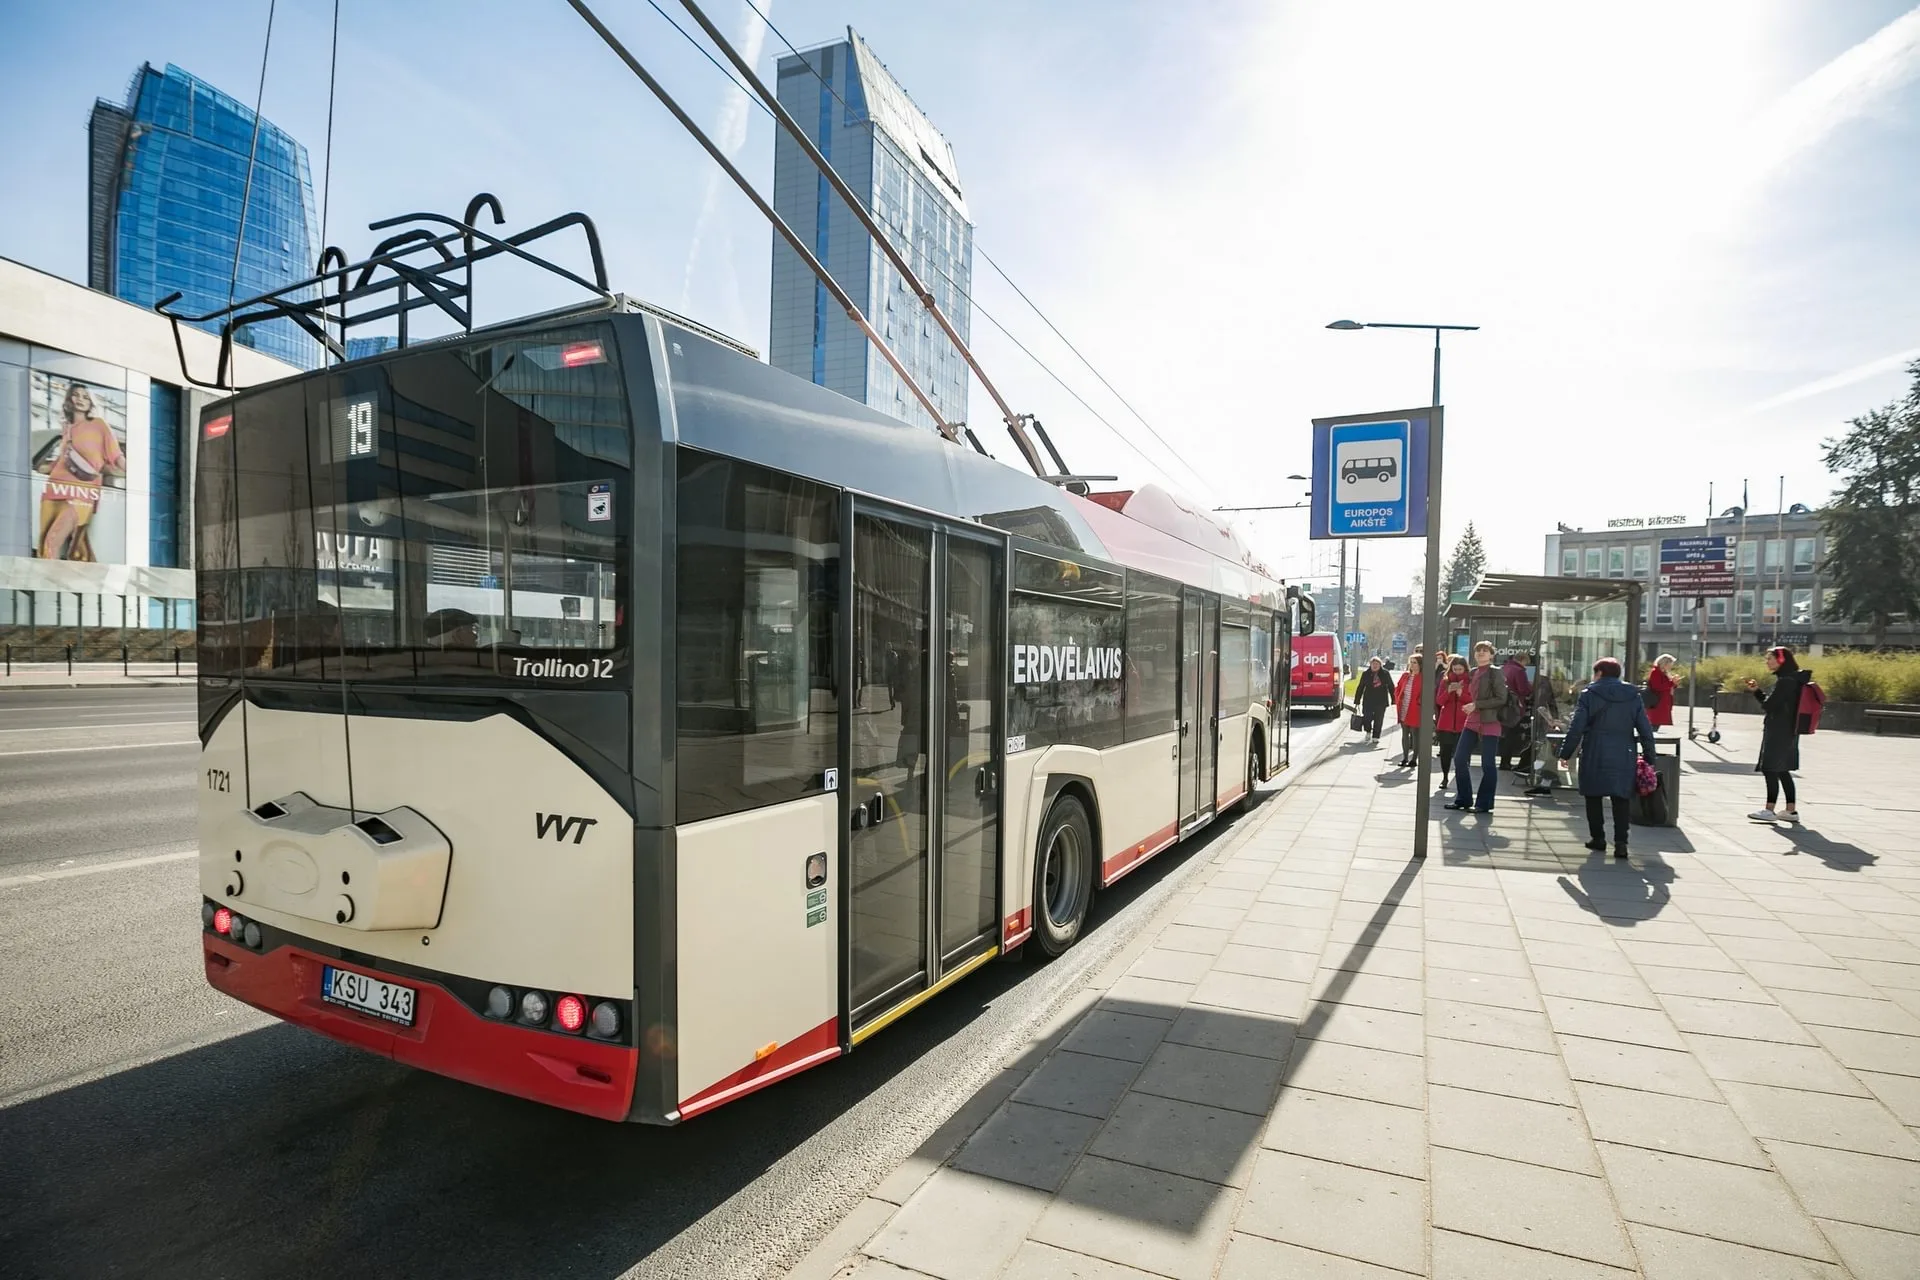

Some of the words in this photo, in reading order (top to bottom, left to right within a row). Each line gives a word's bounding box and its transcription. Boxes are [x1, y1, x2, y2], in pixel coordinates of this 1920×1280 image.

[347, 402, 372, 455] 19
[1344, 508, 1393, 518] EUROPOS
[1350, 517, 1387, 528] AIKŠTĖ
[513, 657, 589, 678] Trollino
[592, 658, 614, 678] 12
[1014, 636, 1122, 683] ERDVĖLAIVIS
[1303, 652, 1327, 667] dpd
[207, 768, 230, 793] 1721
[333, 970, 369, 1003] KSU
[380, 985, 412, 1017] 343
